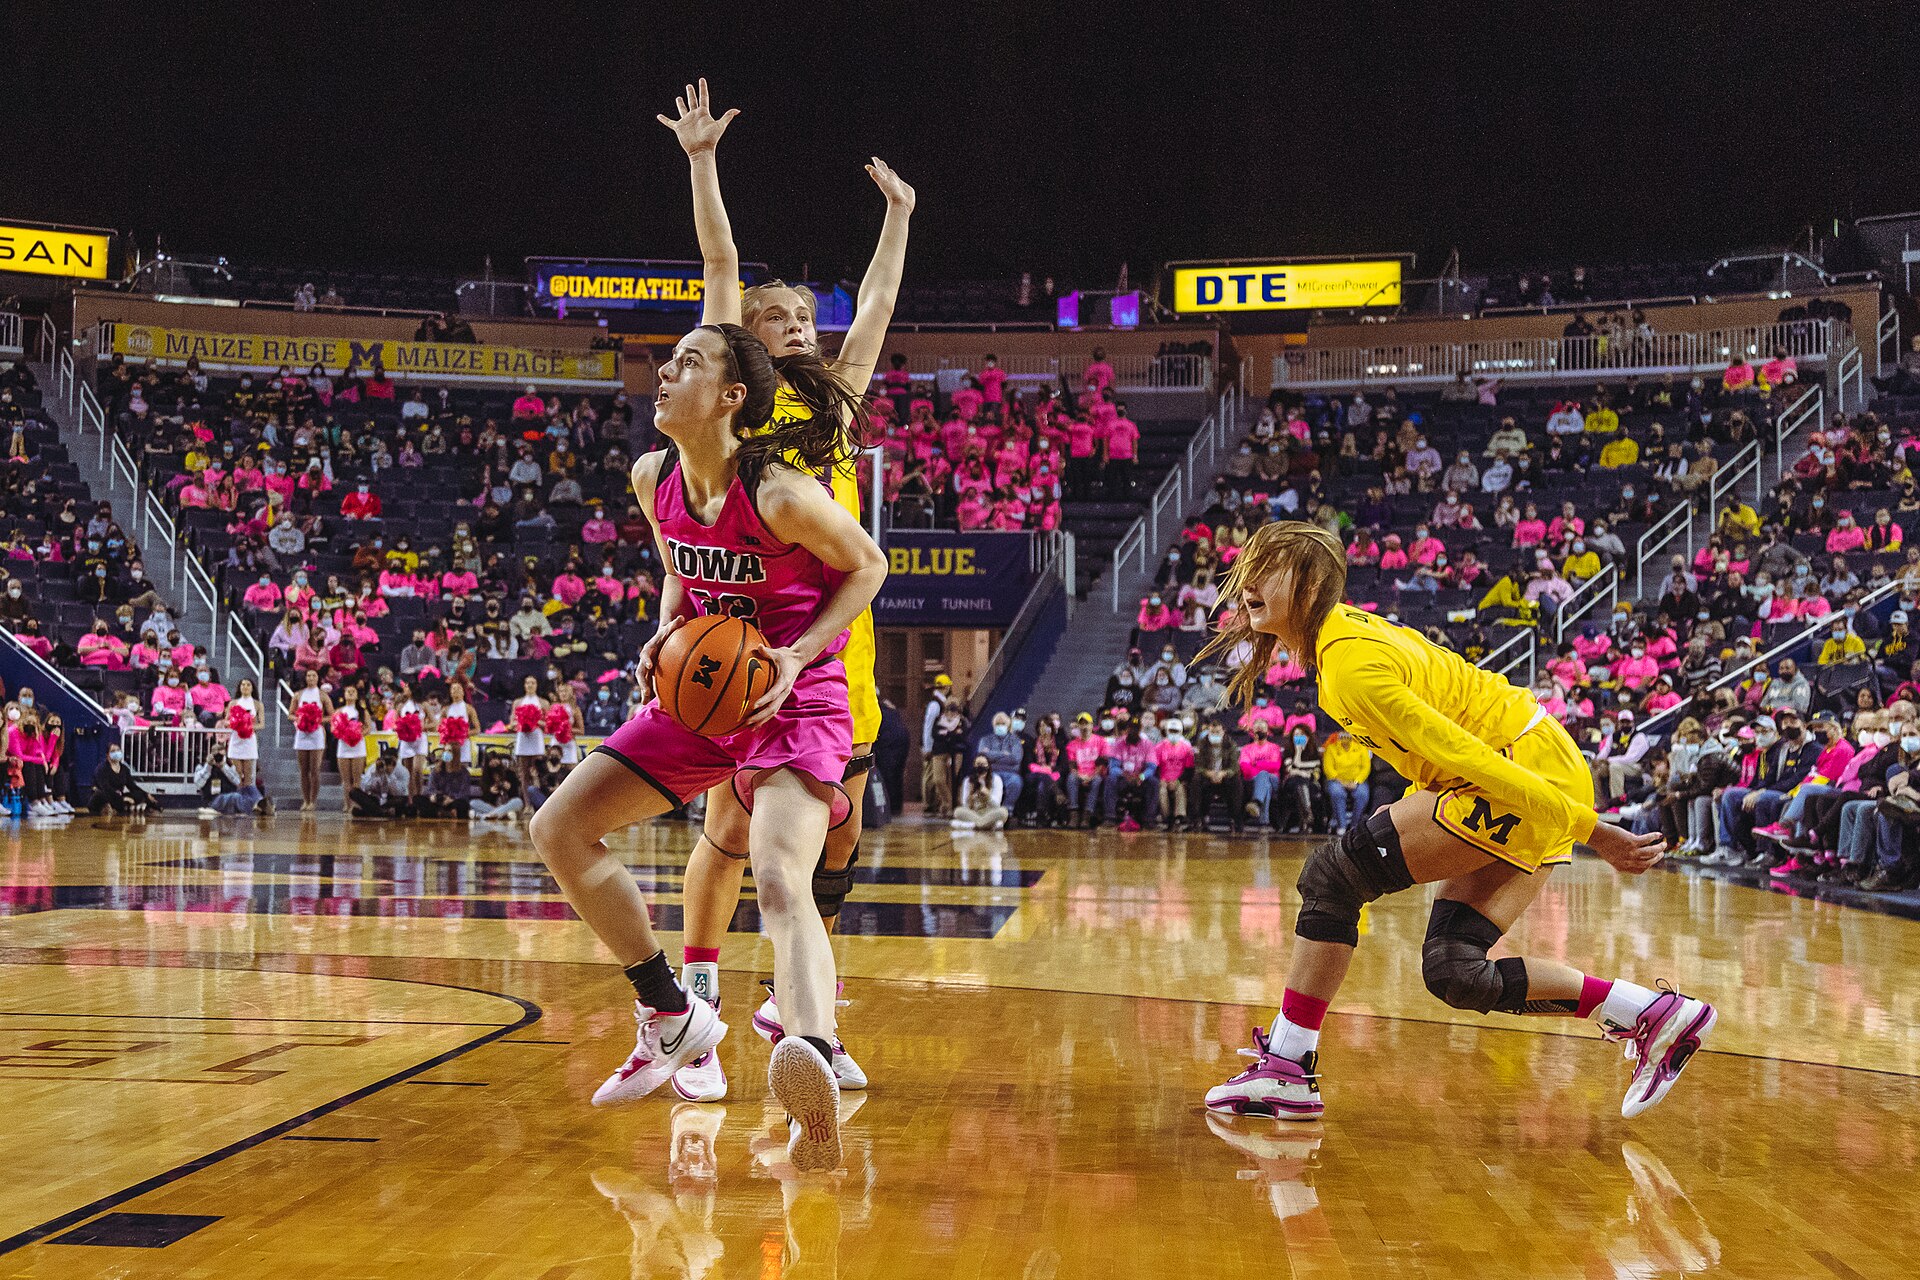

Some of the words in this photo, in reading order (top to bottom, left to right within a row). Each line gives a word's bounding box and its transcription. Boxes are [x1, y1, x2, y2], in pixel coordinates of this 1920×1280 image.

[549, 275, 744, 301] @UMICHATHLE
[1196, 273, 1287, 305] DTE
[166, 333, 253, 359] MAIZE
[263, 340, 337, 364] RAGE
[397, 346, 484, 370] MAIZE
[493, 351, 565, 375] RAGE
[667, 537, 767, 584] IOWA
[888, 547, 977, 576] BLUE
[879, 597, 926, 610] FAMILY
[941, 597, 992, 611] TUNNEL
[691, 654, 723, 690] M
[1461, 795, 1524, 847] M
